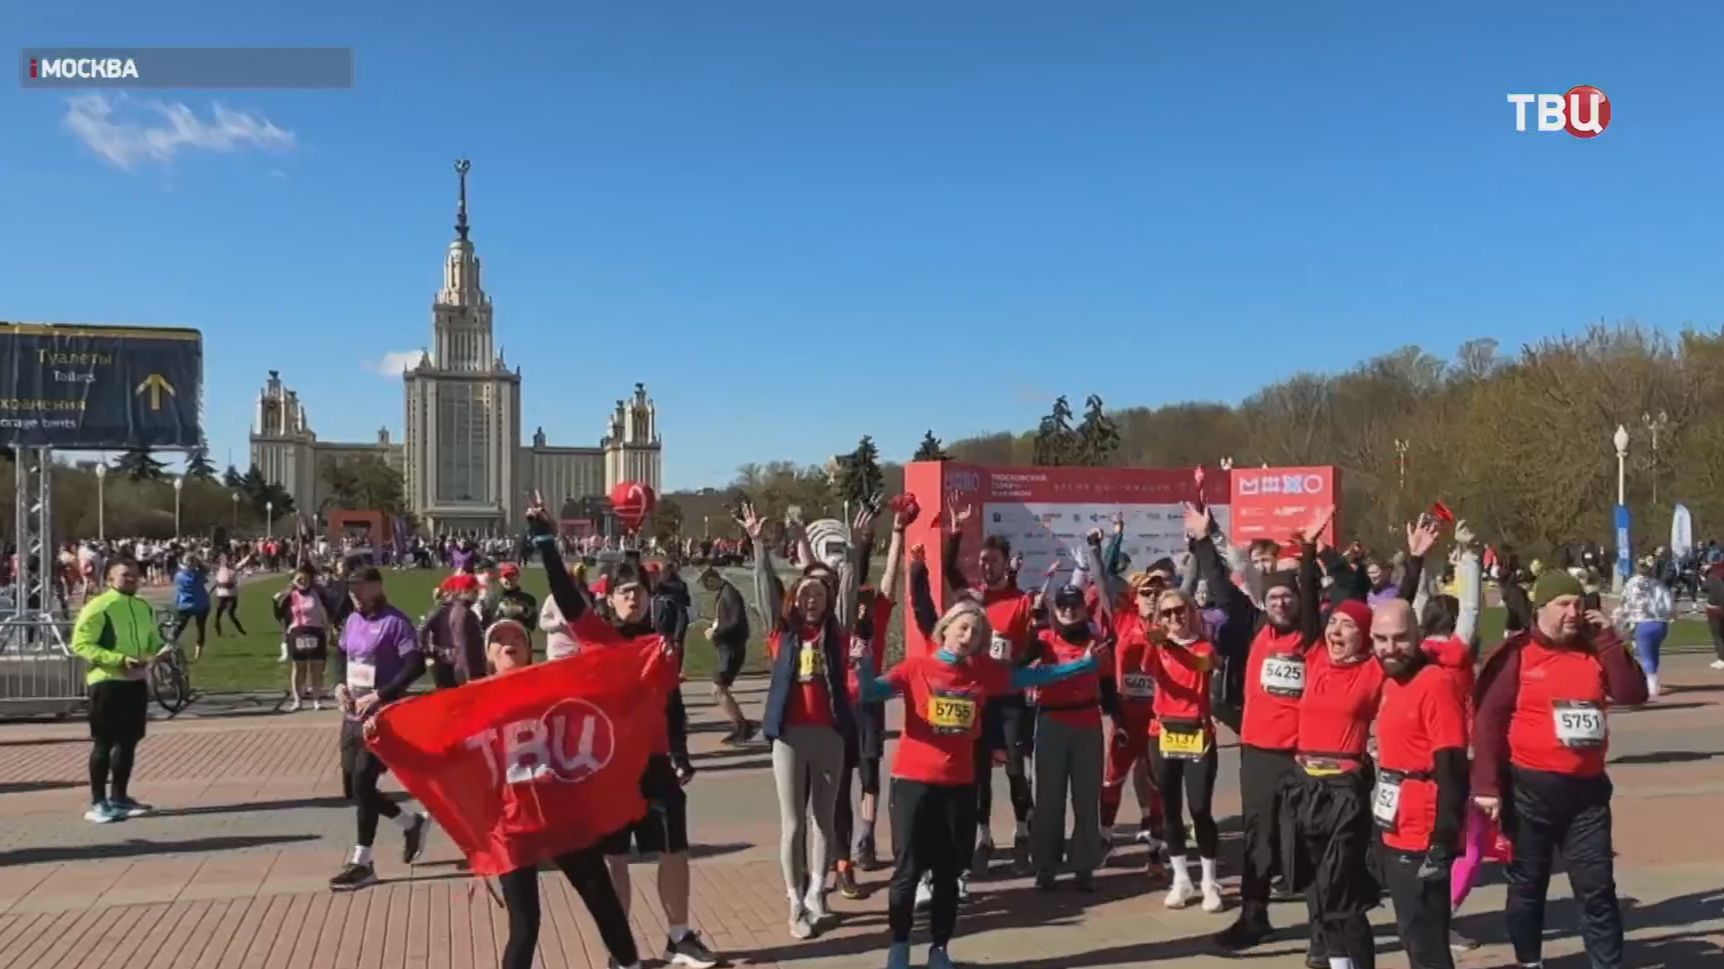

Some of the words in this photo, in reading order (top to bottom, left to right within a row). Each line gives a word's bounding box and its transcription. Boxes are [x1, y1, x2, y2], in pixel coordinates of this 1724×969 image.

[37, 349, 113, 366] Туалеты
[1267, 663, 1301, 680] 5425
[936, 702, 970, 719] 5755
[1562, 713, 1600, 730] 5751
